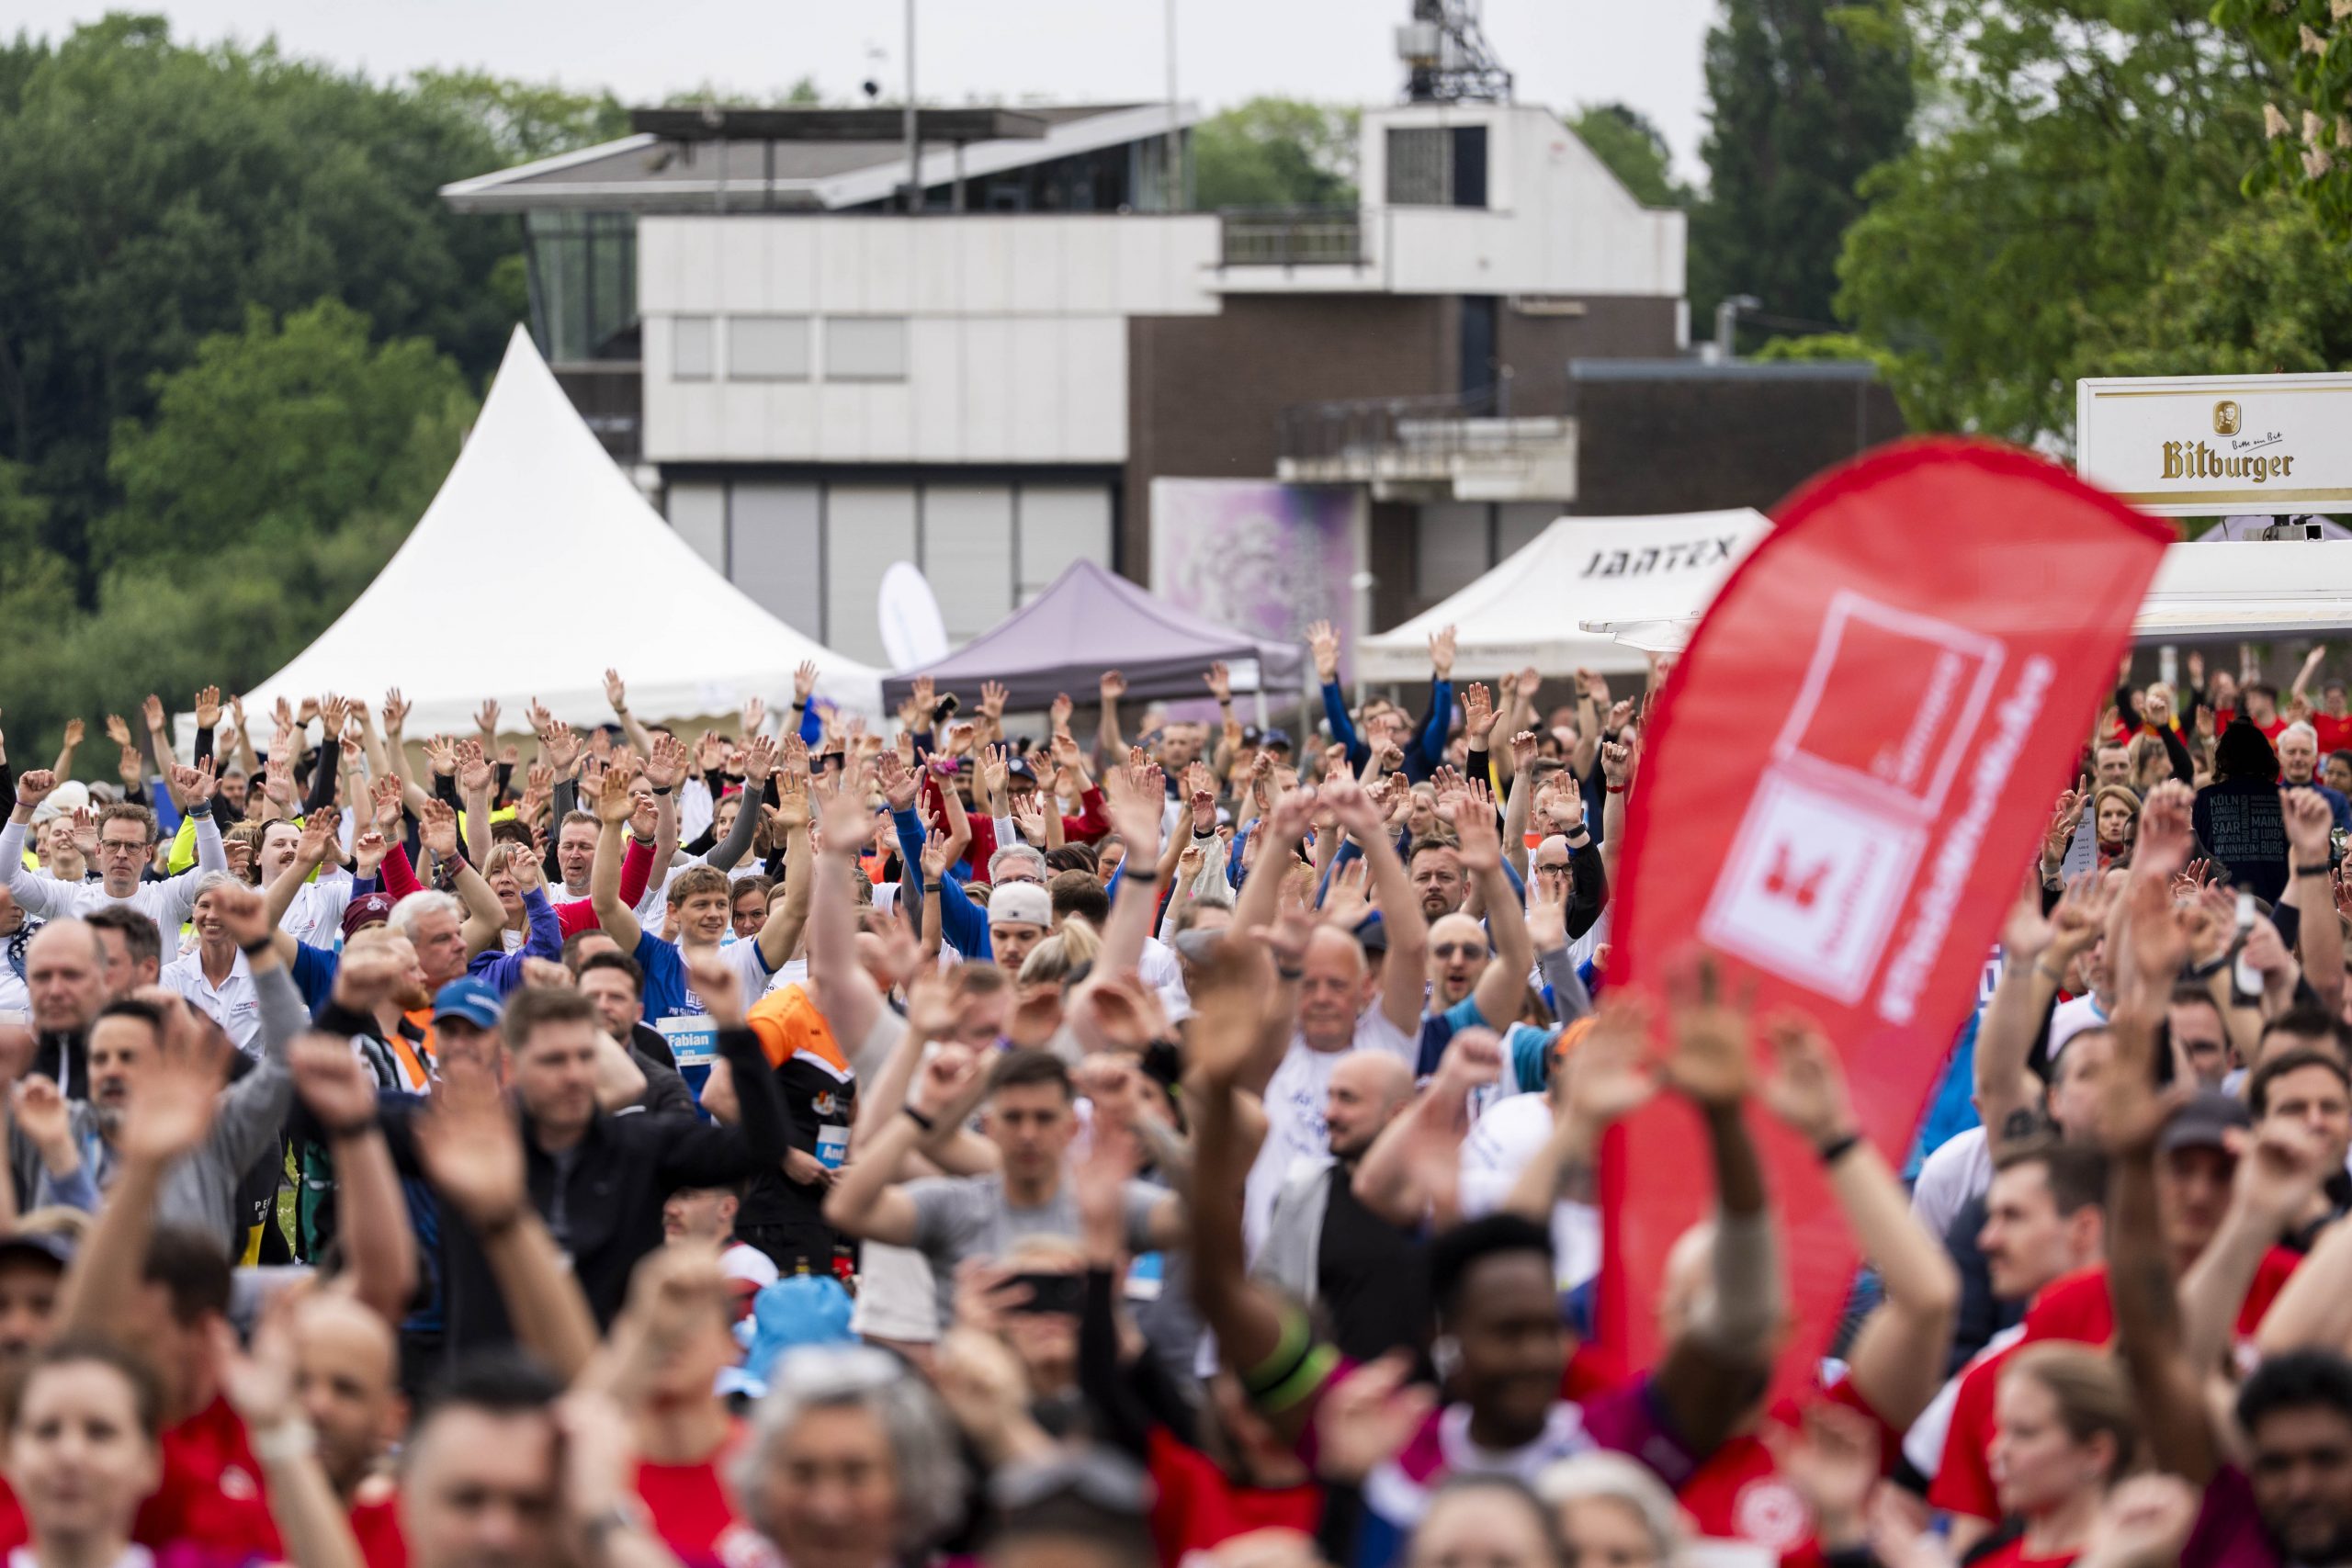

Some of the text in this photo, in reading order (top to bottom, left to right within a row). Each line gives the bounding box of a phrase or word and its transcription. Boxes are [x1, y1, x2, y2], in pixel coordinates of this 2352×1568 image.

[2233, 440, 2250, 450] Bitte
[2267, 432, 2282, 441] Bit
[2161, 440, 2294, 482] Bitburger
[2210, 793, 2239, 807] KÖLN
[2212, 821, 2241, 835] SAAR
[2251, 816, 2284, 828] MAINZ
[2214, 843, 2260, 855] MANNHEIM
[2260, 840, 2284, 854] BURG
[668, 1033, 709, 1047] Fabian
